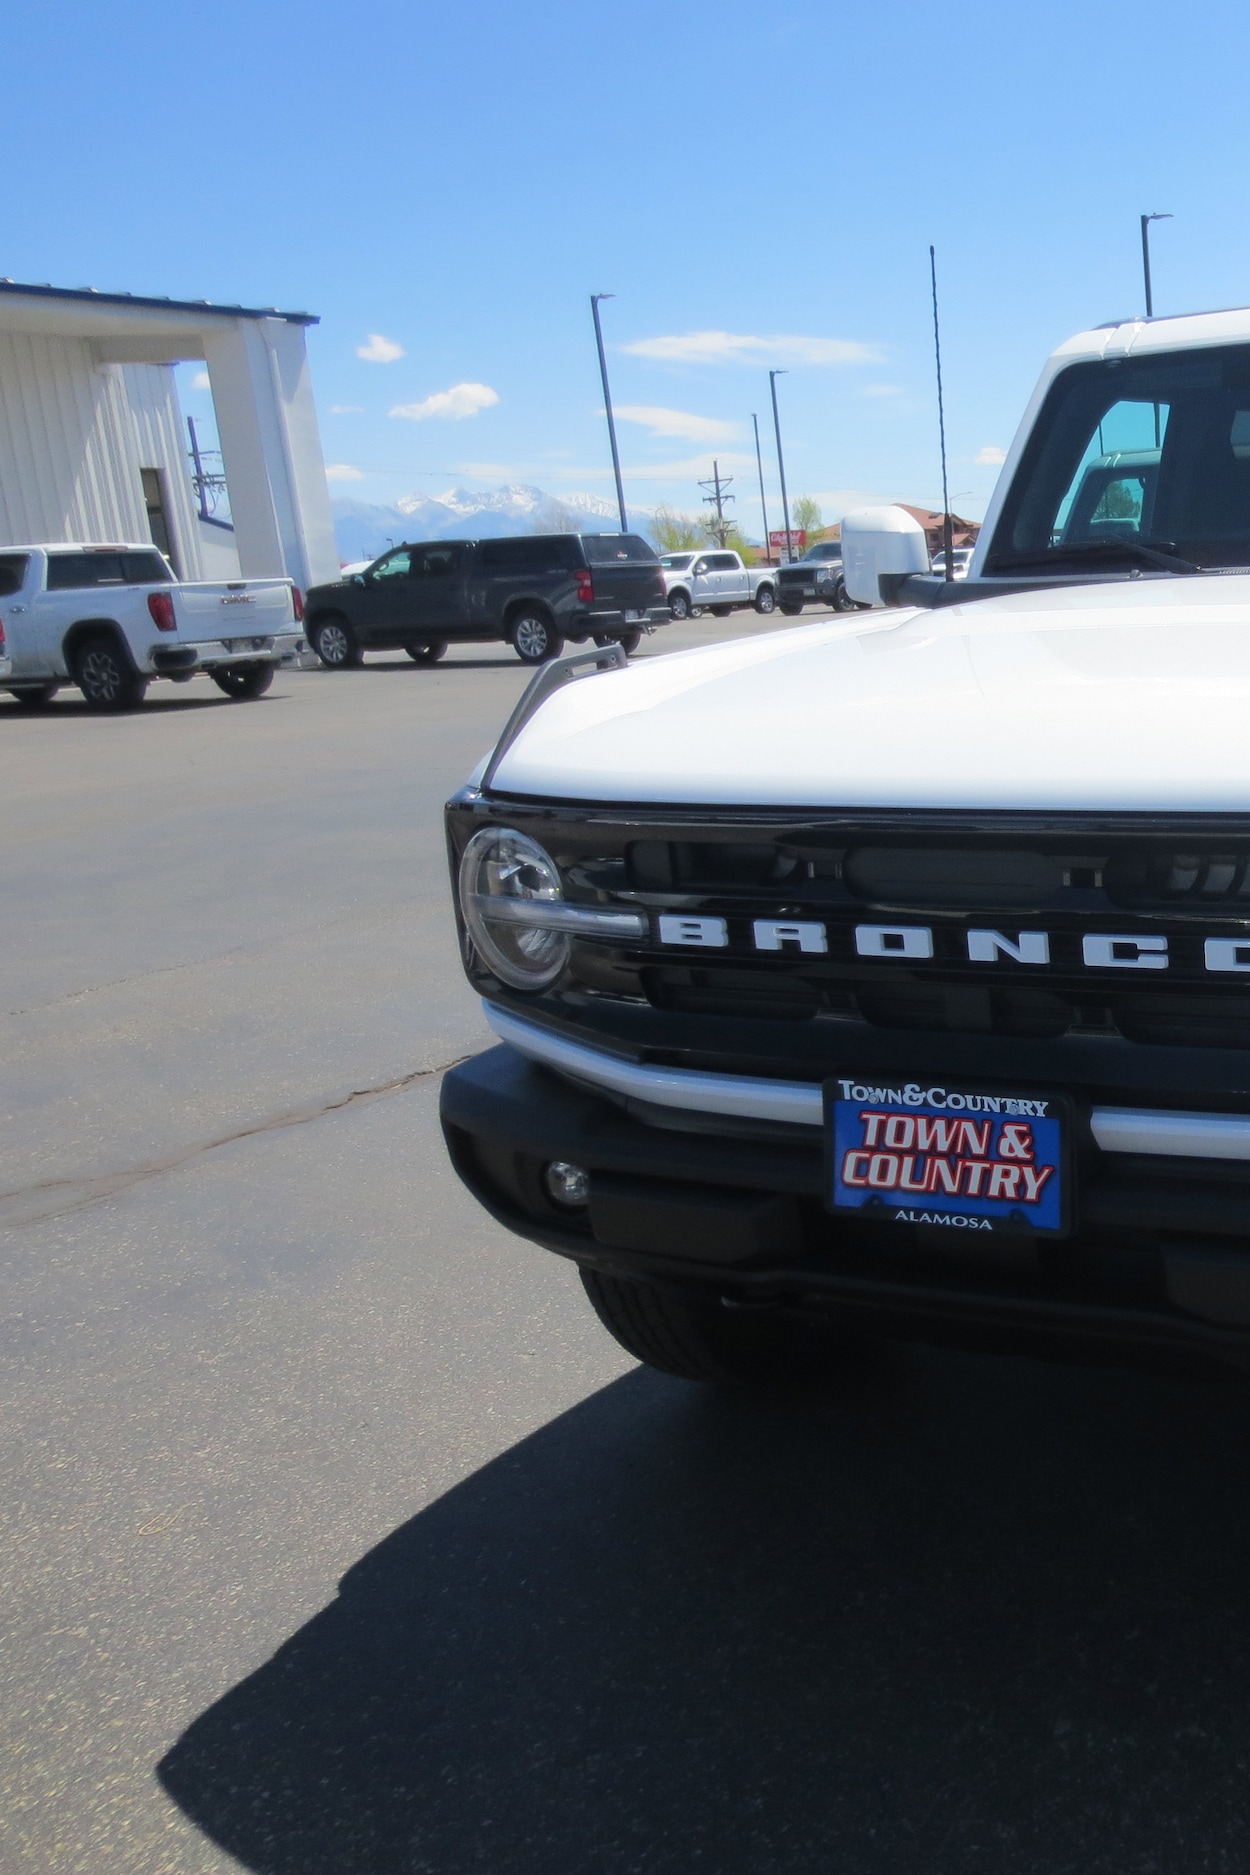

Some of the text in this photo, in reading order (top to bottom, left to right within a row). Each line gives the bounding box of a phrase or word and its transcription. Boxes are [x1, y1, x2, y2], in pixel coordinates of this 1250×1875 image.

[860, 1111, 1034, 1160] TOWN &
[842, 1150, 1053, 1201] COUNTRY
[895, 1209, 993, 1231] ALAMOSA
